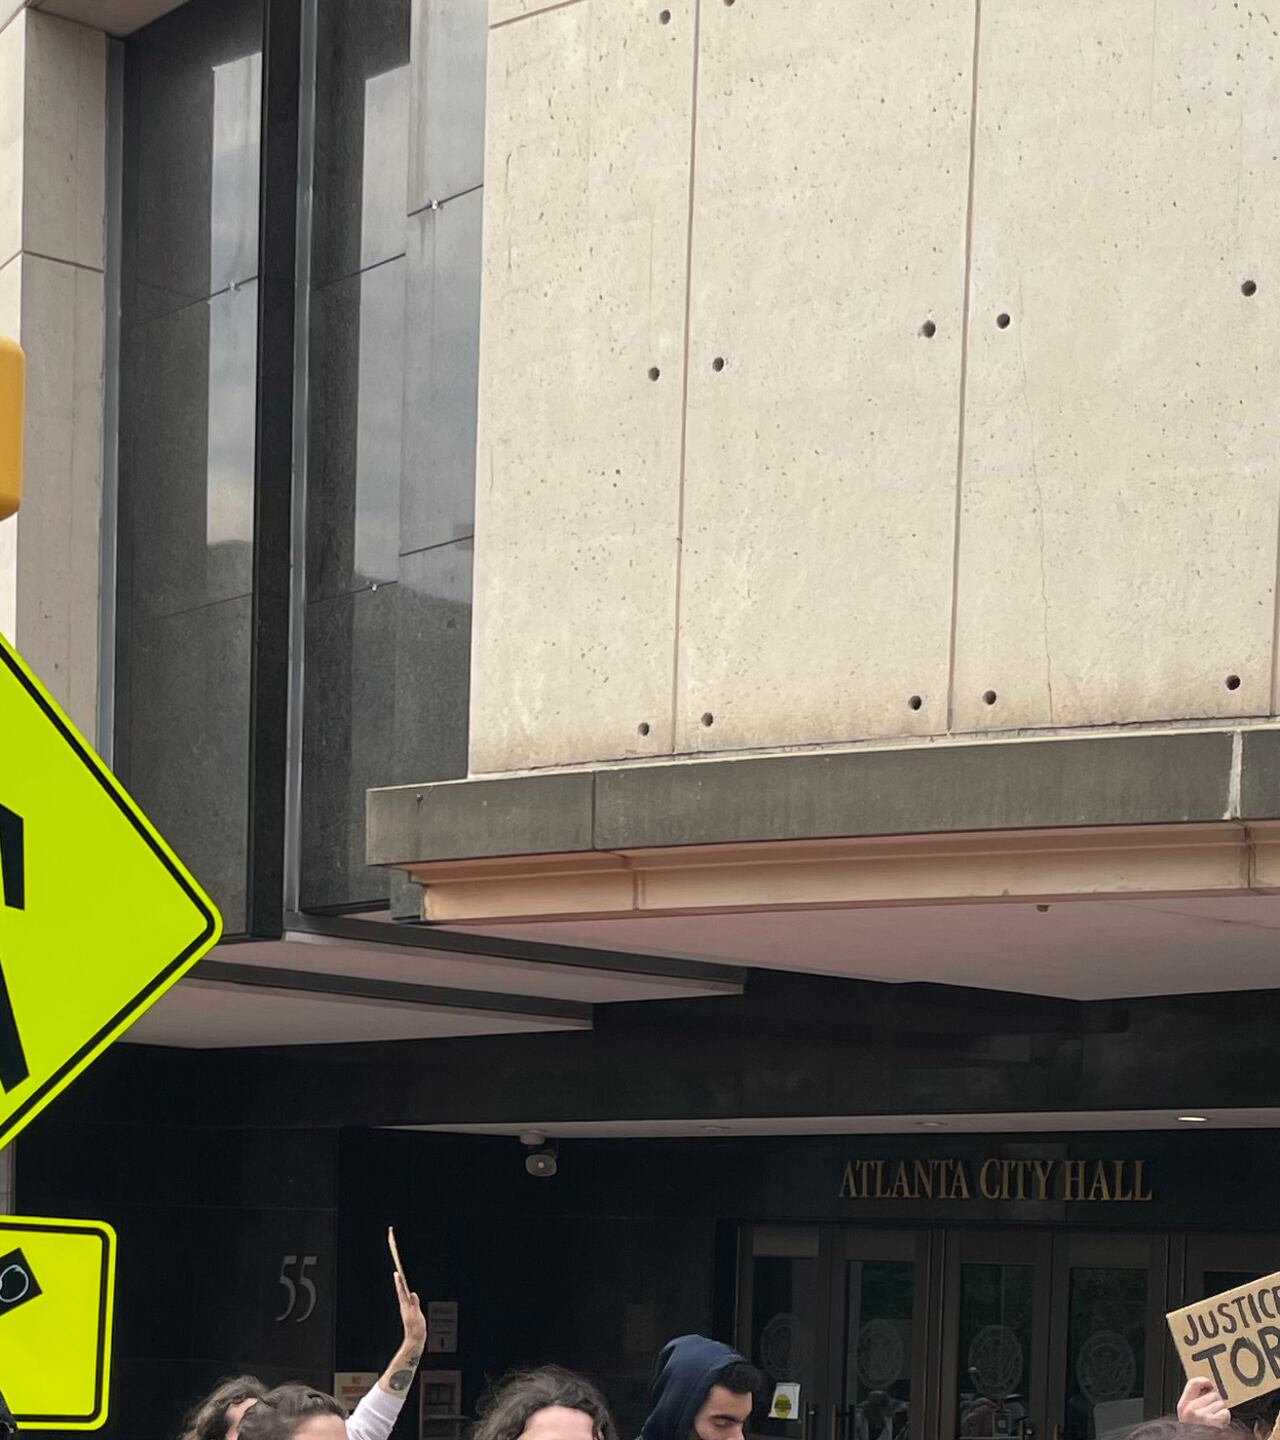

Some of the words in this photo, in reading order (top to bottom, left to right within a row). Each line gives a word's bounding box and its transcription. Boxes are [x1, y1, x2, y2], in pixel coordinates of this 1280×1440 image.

[838, 1158, 969, 1199] ATLANTA
[979, 1158, 1054, 1201] CITY
[1063, 1160, 1153, 1201] HALL
[276, 1255, 318, 1322] 55
